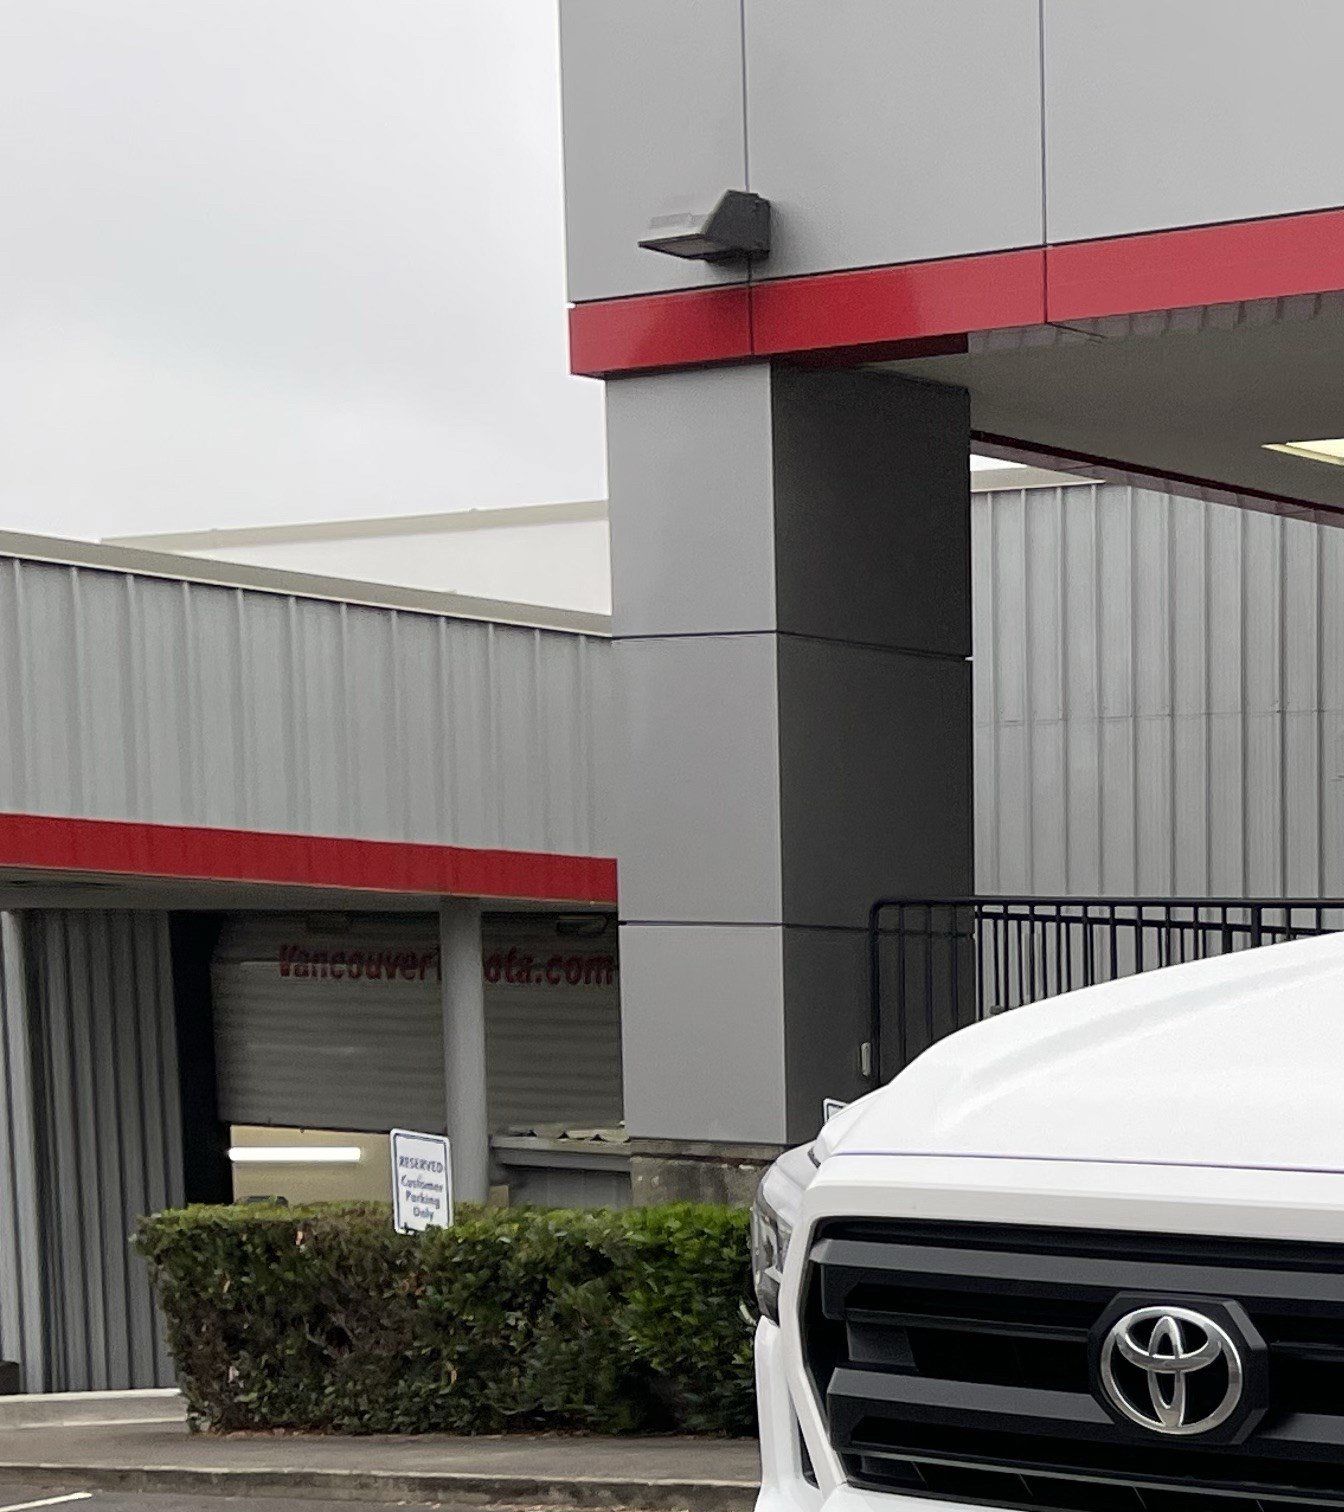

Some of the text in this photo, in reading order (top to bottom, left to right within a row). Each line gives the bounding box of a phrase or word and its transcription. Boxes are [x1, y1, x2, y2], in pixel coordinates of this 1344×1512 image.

[398, 1155, 444, 1174] RESERVED
[405, 1189, 440, 1209] Parking
[413, 1205, 434, 1222] Only
